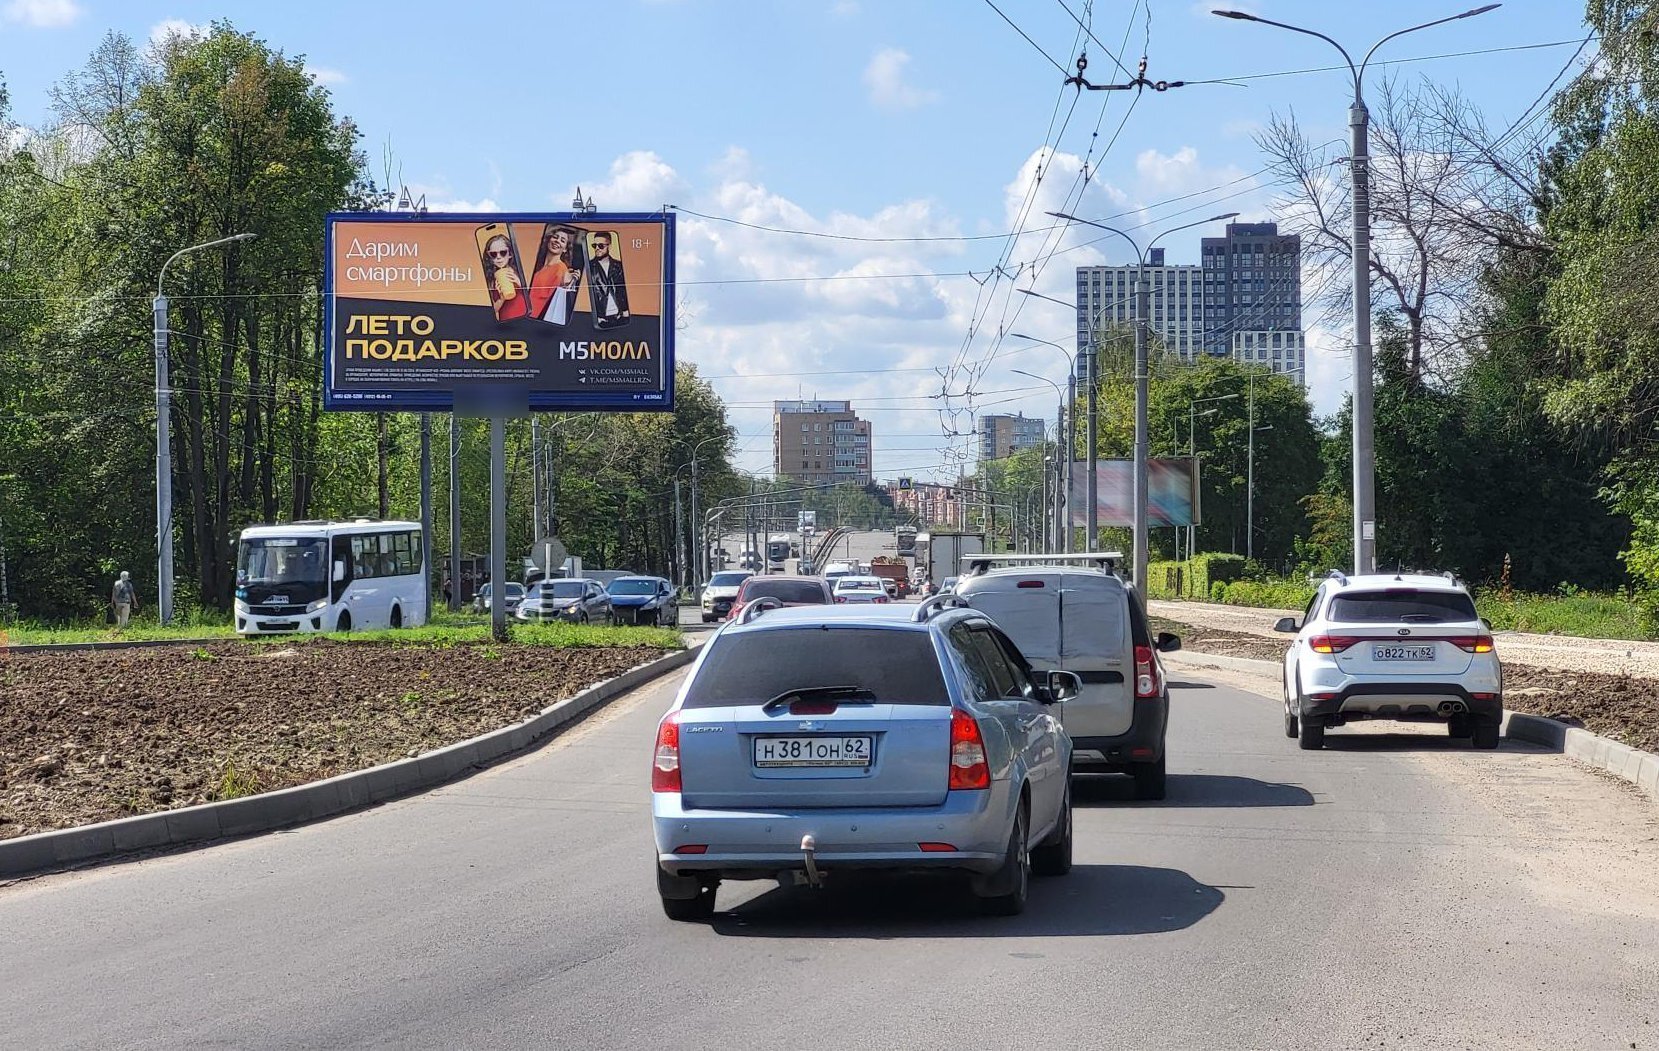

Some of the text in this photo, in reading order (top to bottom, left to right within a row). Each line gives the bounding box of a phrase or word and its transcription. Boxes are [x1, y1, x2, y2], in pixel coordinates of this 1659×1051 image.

[346, 237, 418, 262] Дарим
[632, 238, 652, 250] 18+
[346, 262, 472, 287] смартфоны
[345, 315, 435, 336] ЛЕТО
[345, 339, 529, 362] ПОДАРКОВ
[1420, 647, 1431, 656] 62
[844, 739, 864, 753] 62
